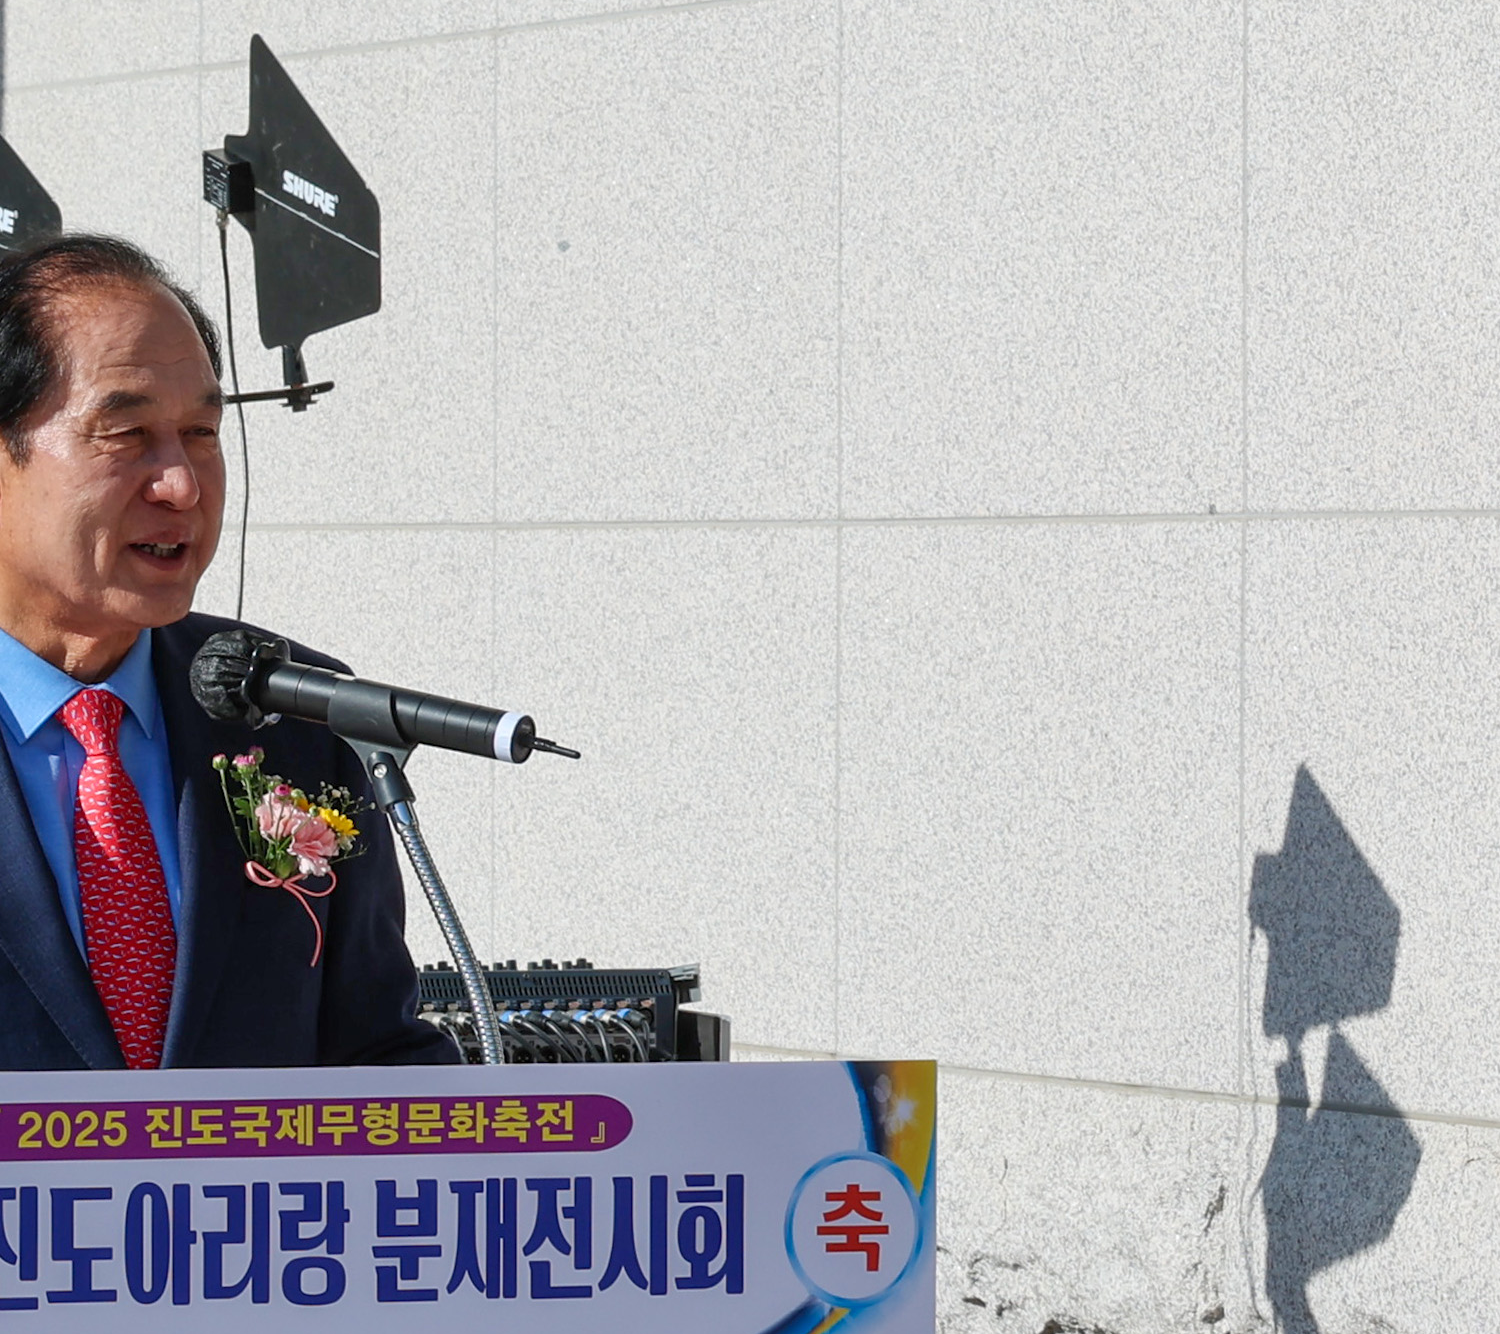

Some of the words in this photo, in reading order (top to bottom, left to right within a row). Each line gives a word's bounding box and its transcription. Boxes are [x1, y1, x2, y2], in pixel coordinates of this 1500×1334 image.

[282, 169, 338, 217] SHURE
[18, 1110, 128, 1148] 2025
[145, 1099, 574, 1149] 진도국제무형문화축전
[371, 1173, 746, 1304] 분재전시회
[816, 1183, 890, 1273] 축
